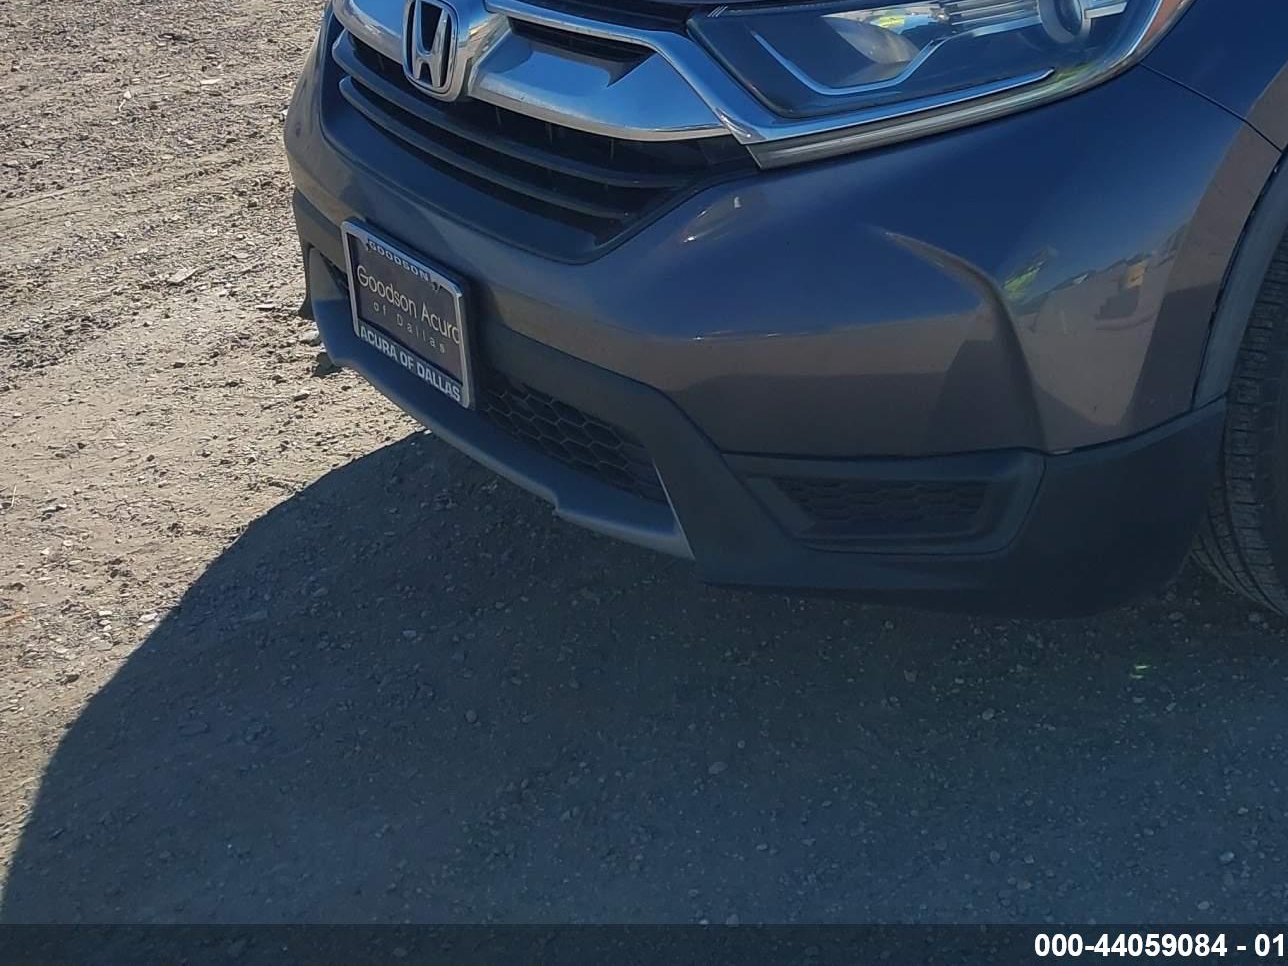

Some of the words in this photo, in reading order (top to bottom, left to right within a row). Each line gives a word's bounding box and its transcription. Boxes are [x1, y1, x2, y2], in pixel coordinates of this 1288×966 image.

[368, 240, 430, 282] GOODSON
[356, 265, 417, 318] Goodson
[373, 301, 387, 316] of
[395, 313, 446, 354] Dallas
[359, 325, 398, 363] ACURA
[400, 352, 415, 370] OF
[416, 362, 461, 402] DALLAS
